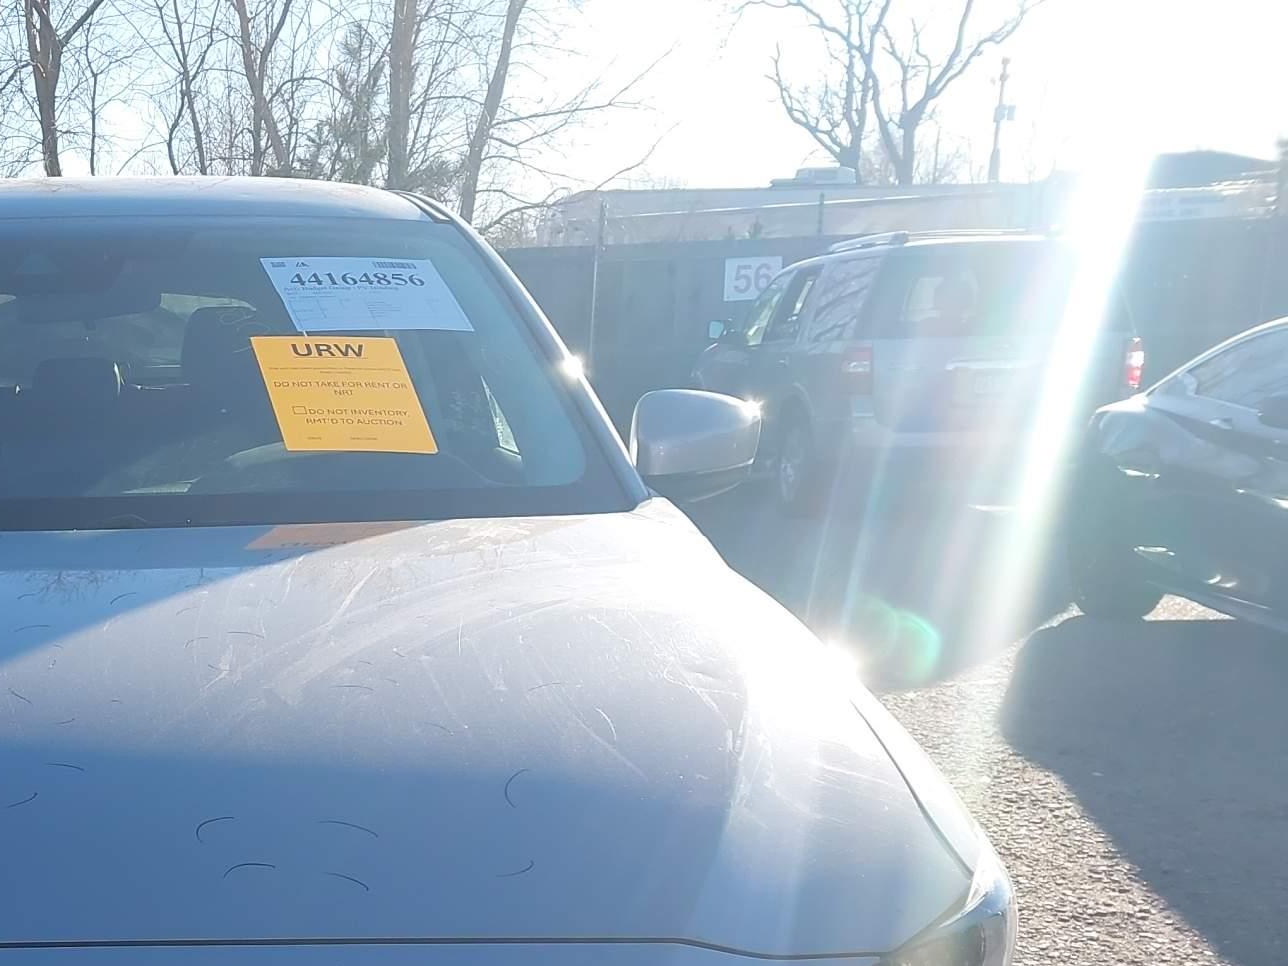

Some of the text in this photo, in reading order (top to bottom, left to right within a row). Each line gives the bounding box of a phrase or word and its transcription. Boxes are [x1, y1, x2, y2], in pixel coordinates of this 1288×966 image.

[290, 272, 425, 287] 44164856
[733, 263, 773, 294] 56
[291, 343, 363, 357] URW
